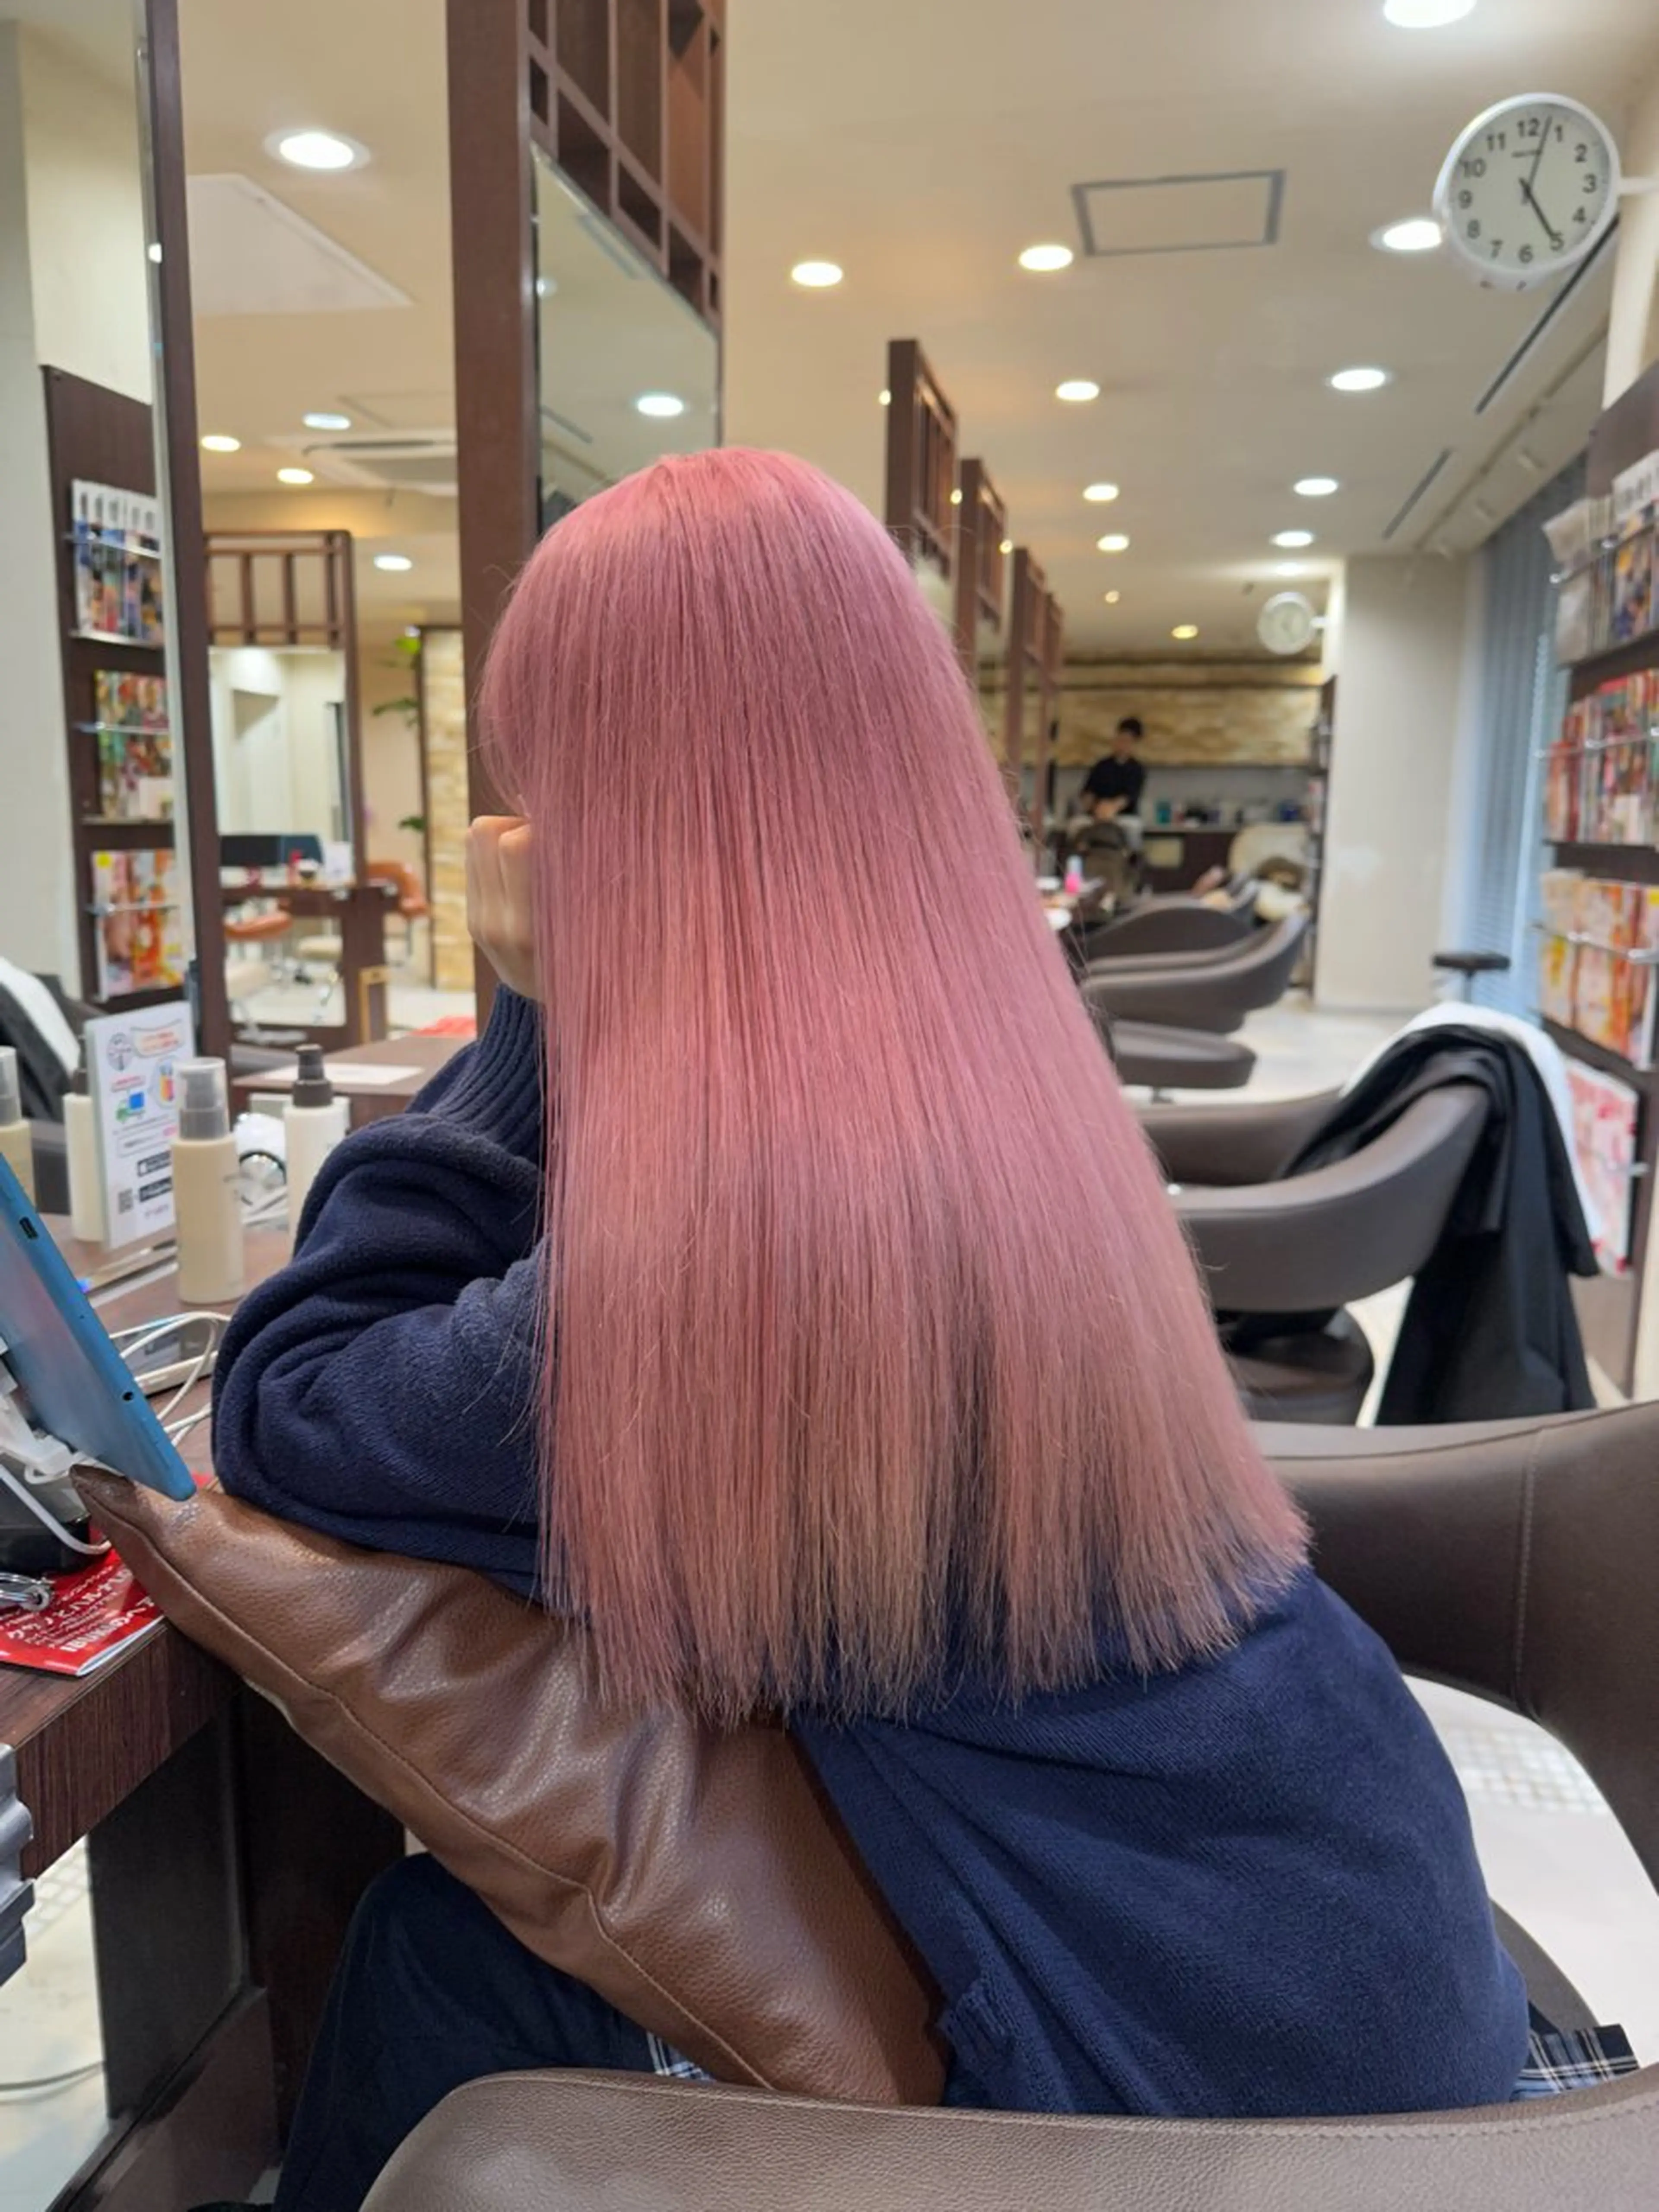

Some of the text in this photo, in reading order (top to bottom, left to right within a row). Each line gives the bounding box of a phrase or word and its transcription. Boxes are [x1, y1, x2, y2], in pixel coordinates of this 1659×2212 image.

[1517, 118, 1540, 137] 12
[1555, 125, 1563, 143] 1
[1487, 133, 1505, 151] 11
[1574, 143, 1588, 163] 2
[1461, 159, 1486, 178] 10
[1582, 174, 1596, 194] 3
[1459, 189, 1472, 209] 9
[1573, 207, 1586, 223] 4
[1467, 219, 1480, 239] 8
[1491, 239, 1503, 258] 7
[1550, 231, 1564, 251] 5
[1519, 244, 1533, 263] 6
